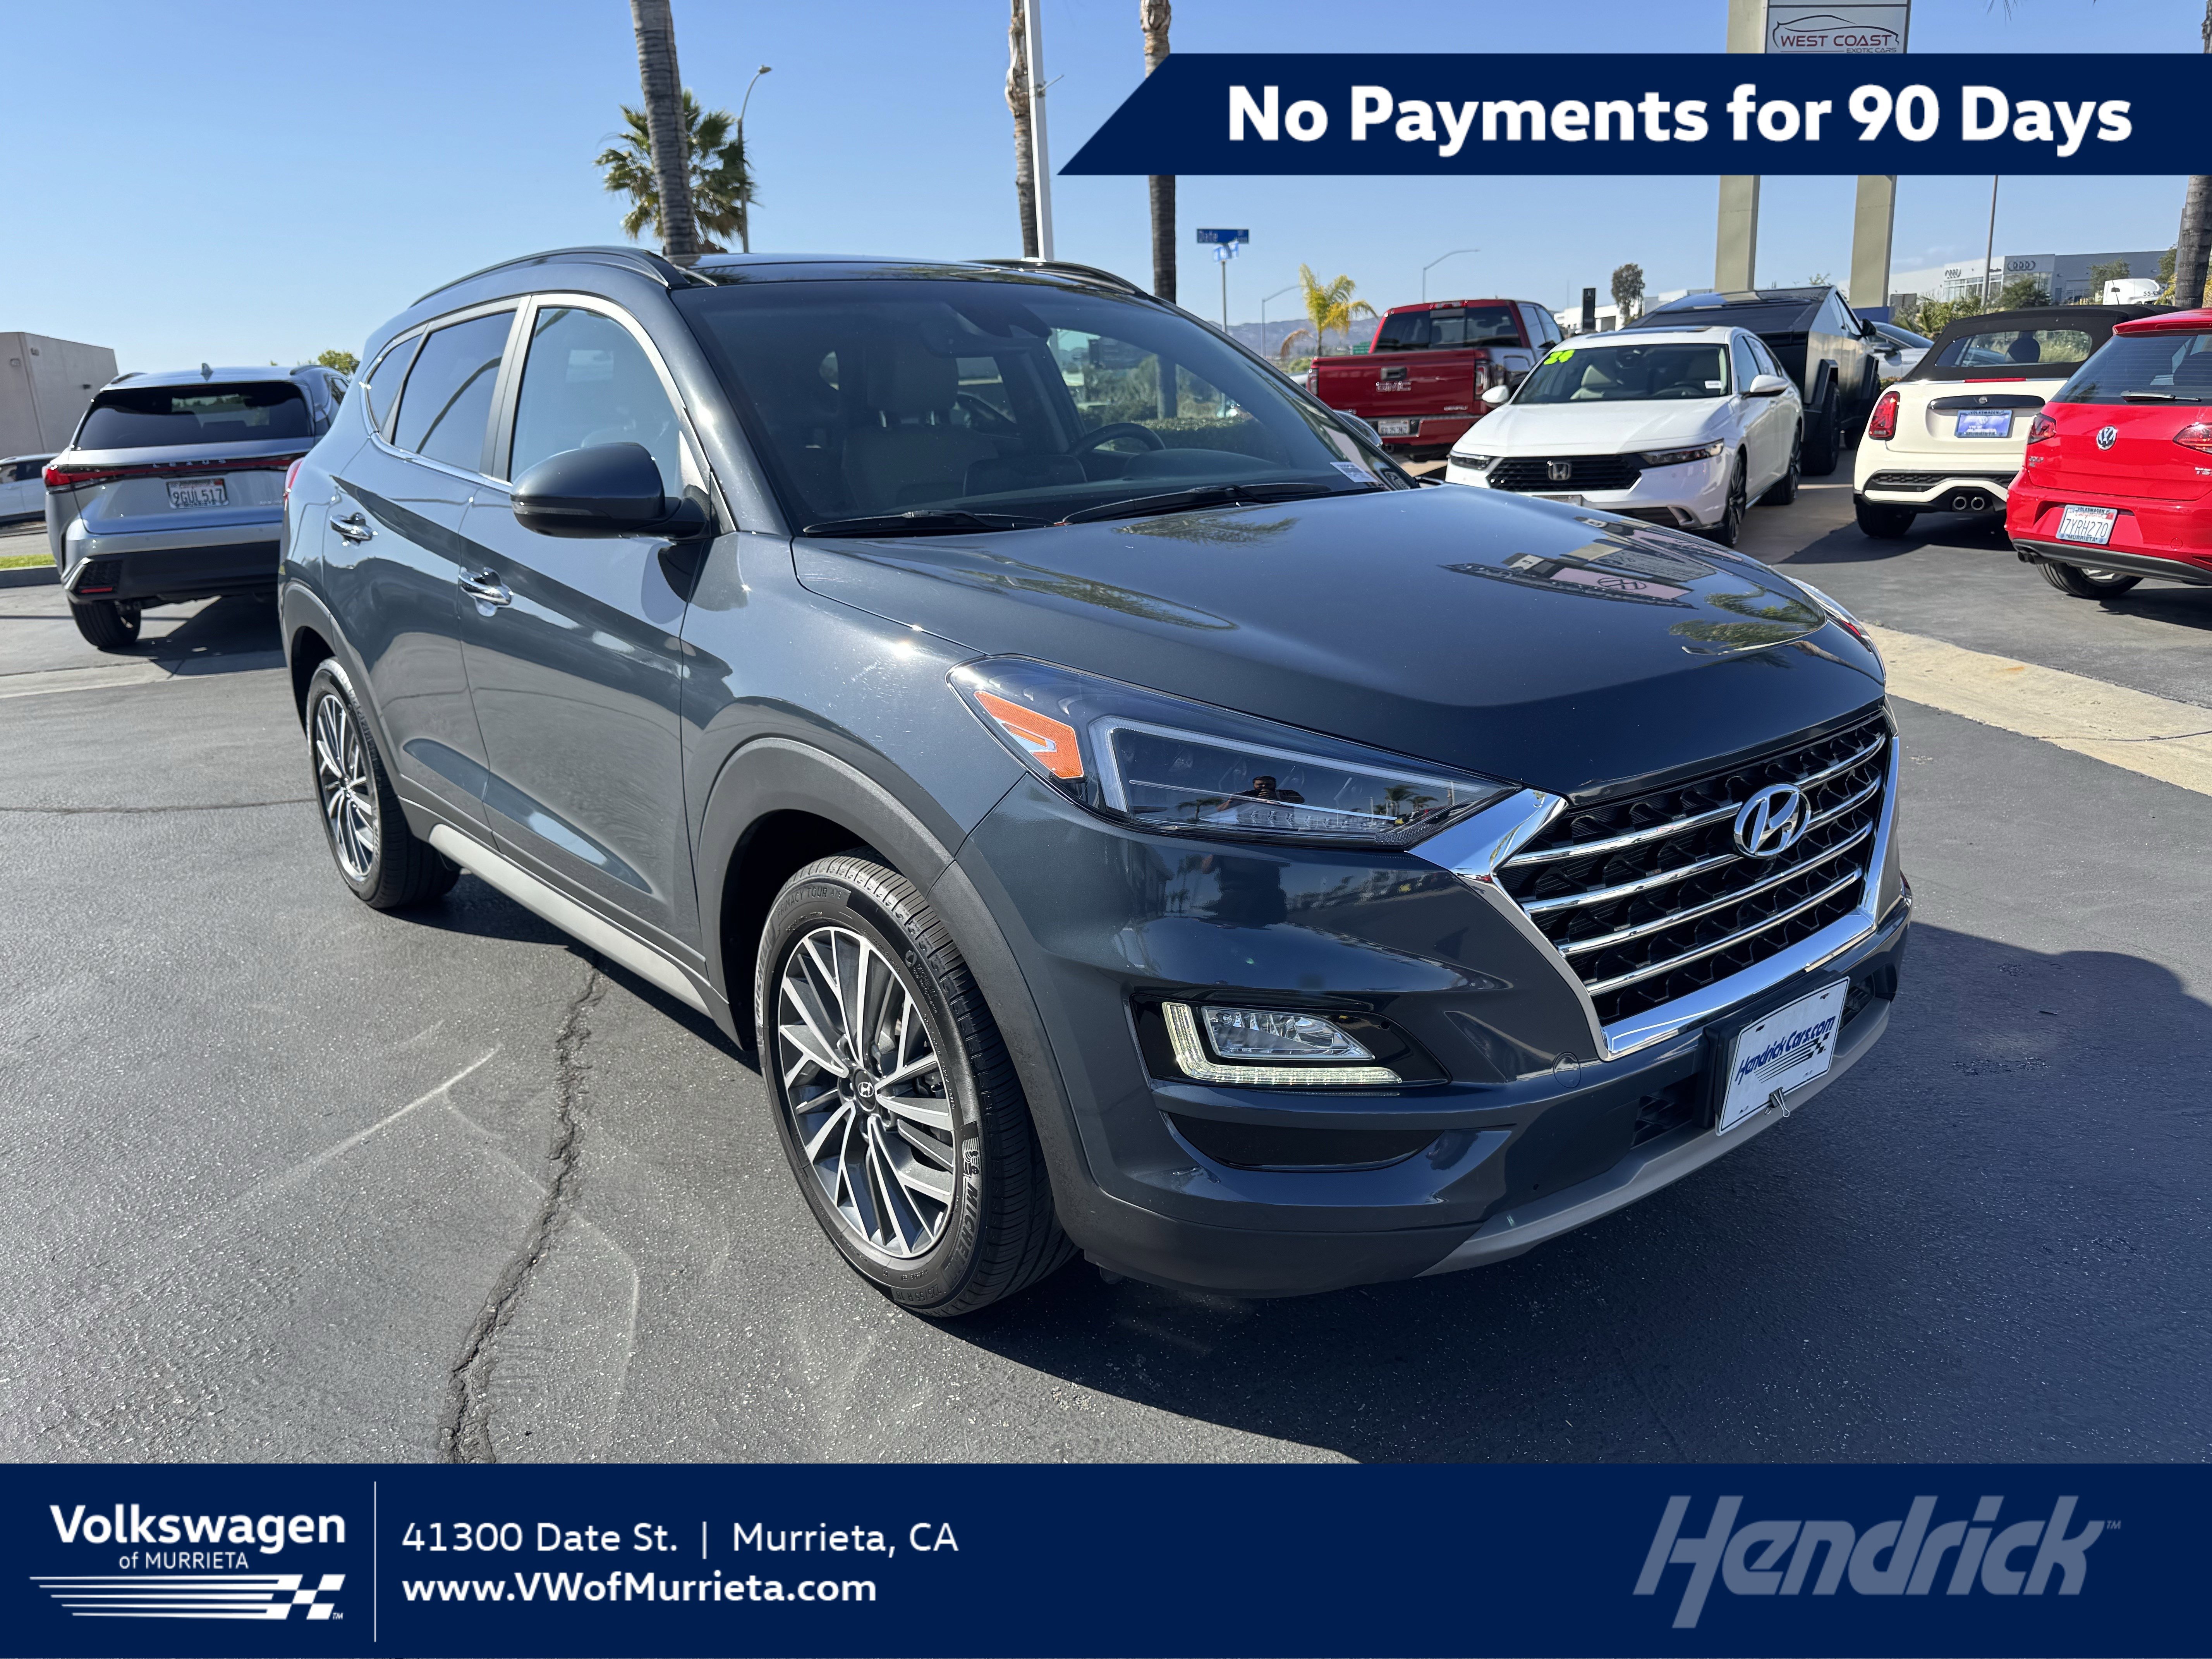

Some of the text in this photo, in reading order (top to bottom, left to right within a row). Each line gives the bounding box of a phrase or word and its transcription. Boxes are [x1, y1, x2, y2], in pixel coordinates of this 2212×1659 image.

[1781, 35, 1892, 47] WEST COAST
[173, 488, 222, 505] 9GUL517
[2063, 519, 2109, 538] 7YRH270
[777, 890, 804, 919] PRIMACY
[807, 888, 828, 898] TOUR
[896, 1284, 941, 1302] 225/55 R 18
